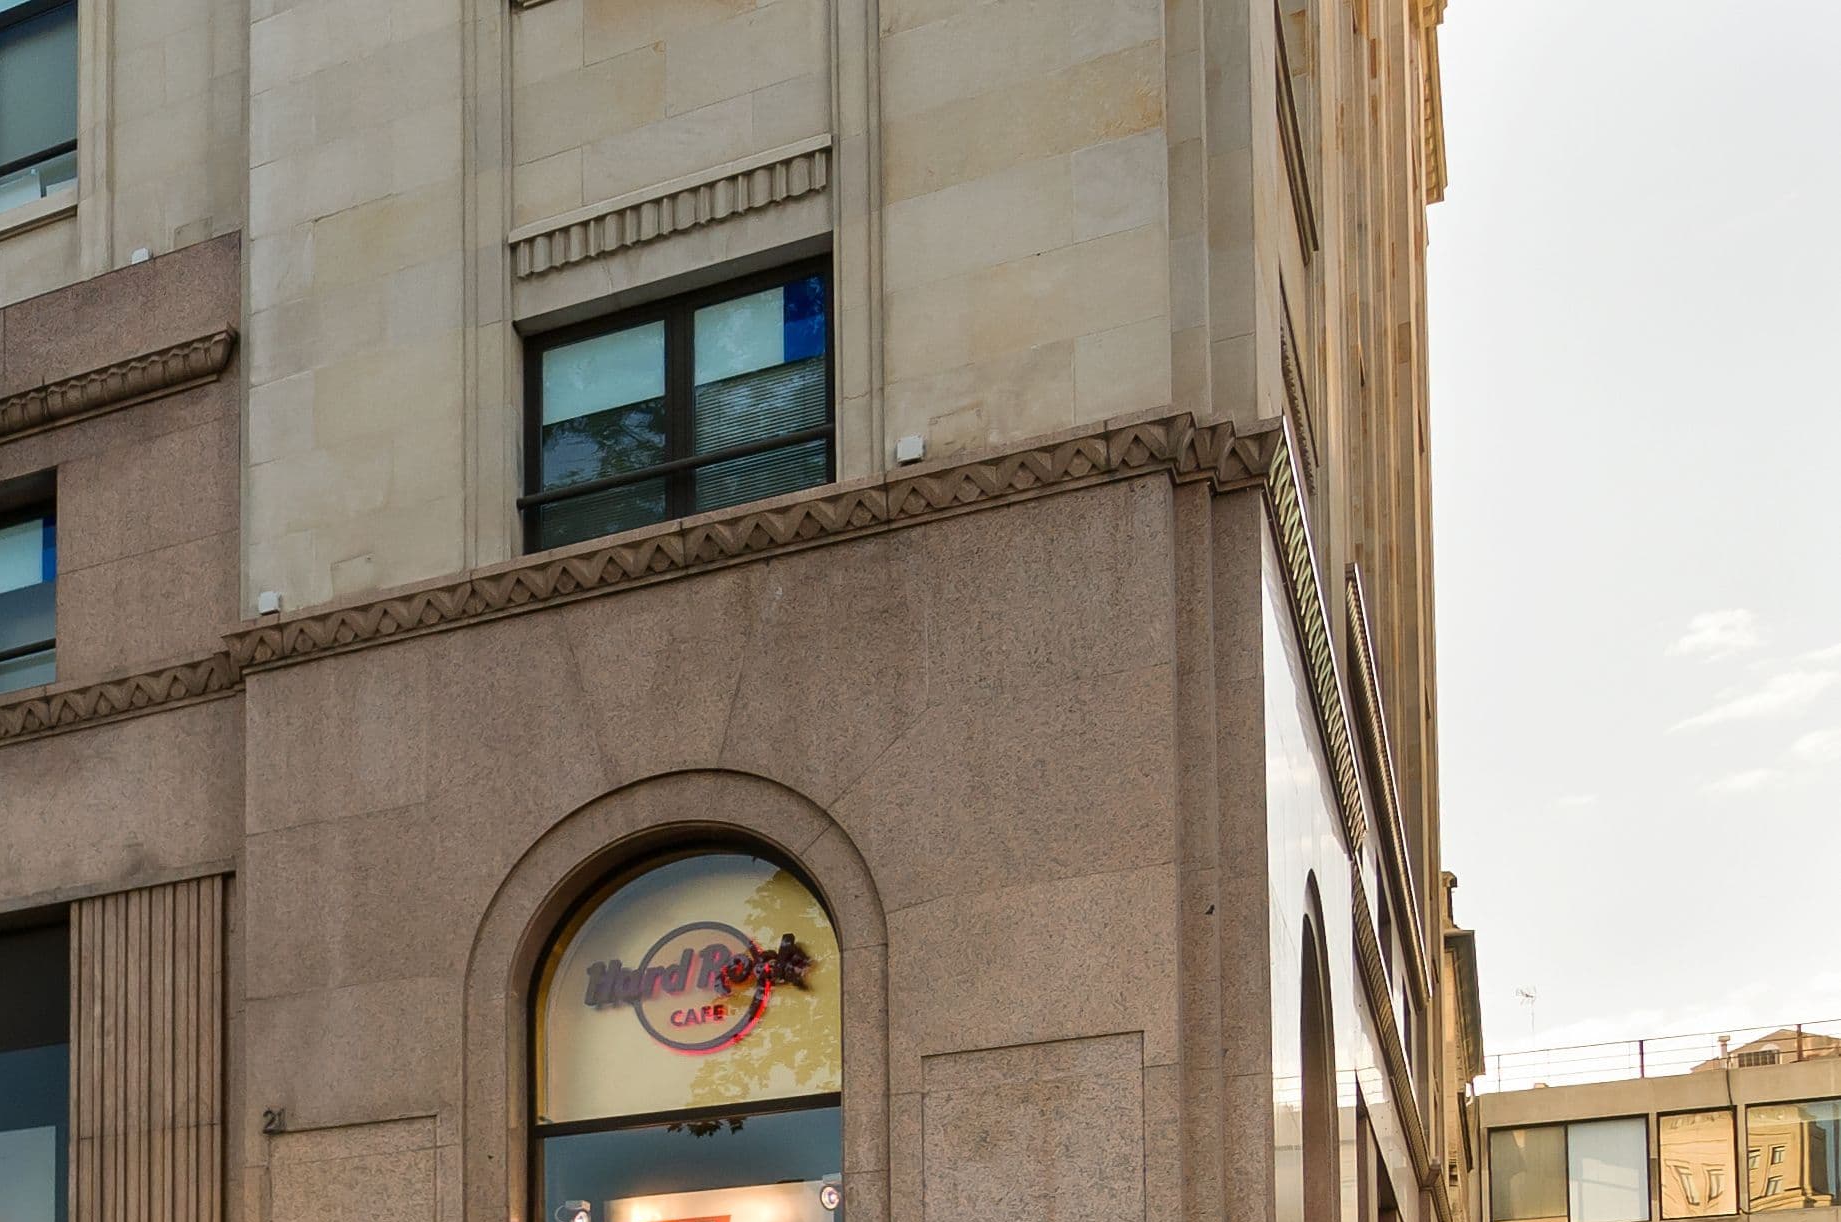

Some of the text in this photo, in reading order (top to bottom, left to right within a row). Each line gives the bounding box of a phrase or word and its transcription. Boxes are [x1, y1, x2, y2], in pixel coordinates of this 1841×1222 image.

[584, 933, 812, 1007] Hard Rock
[670, 1004, 725, 1028] CAFE
